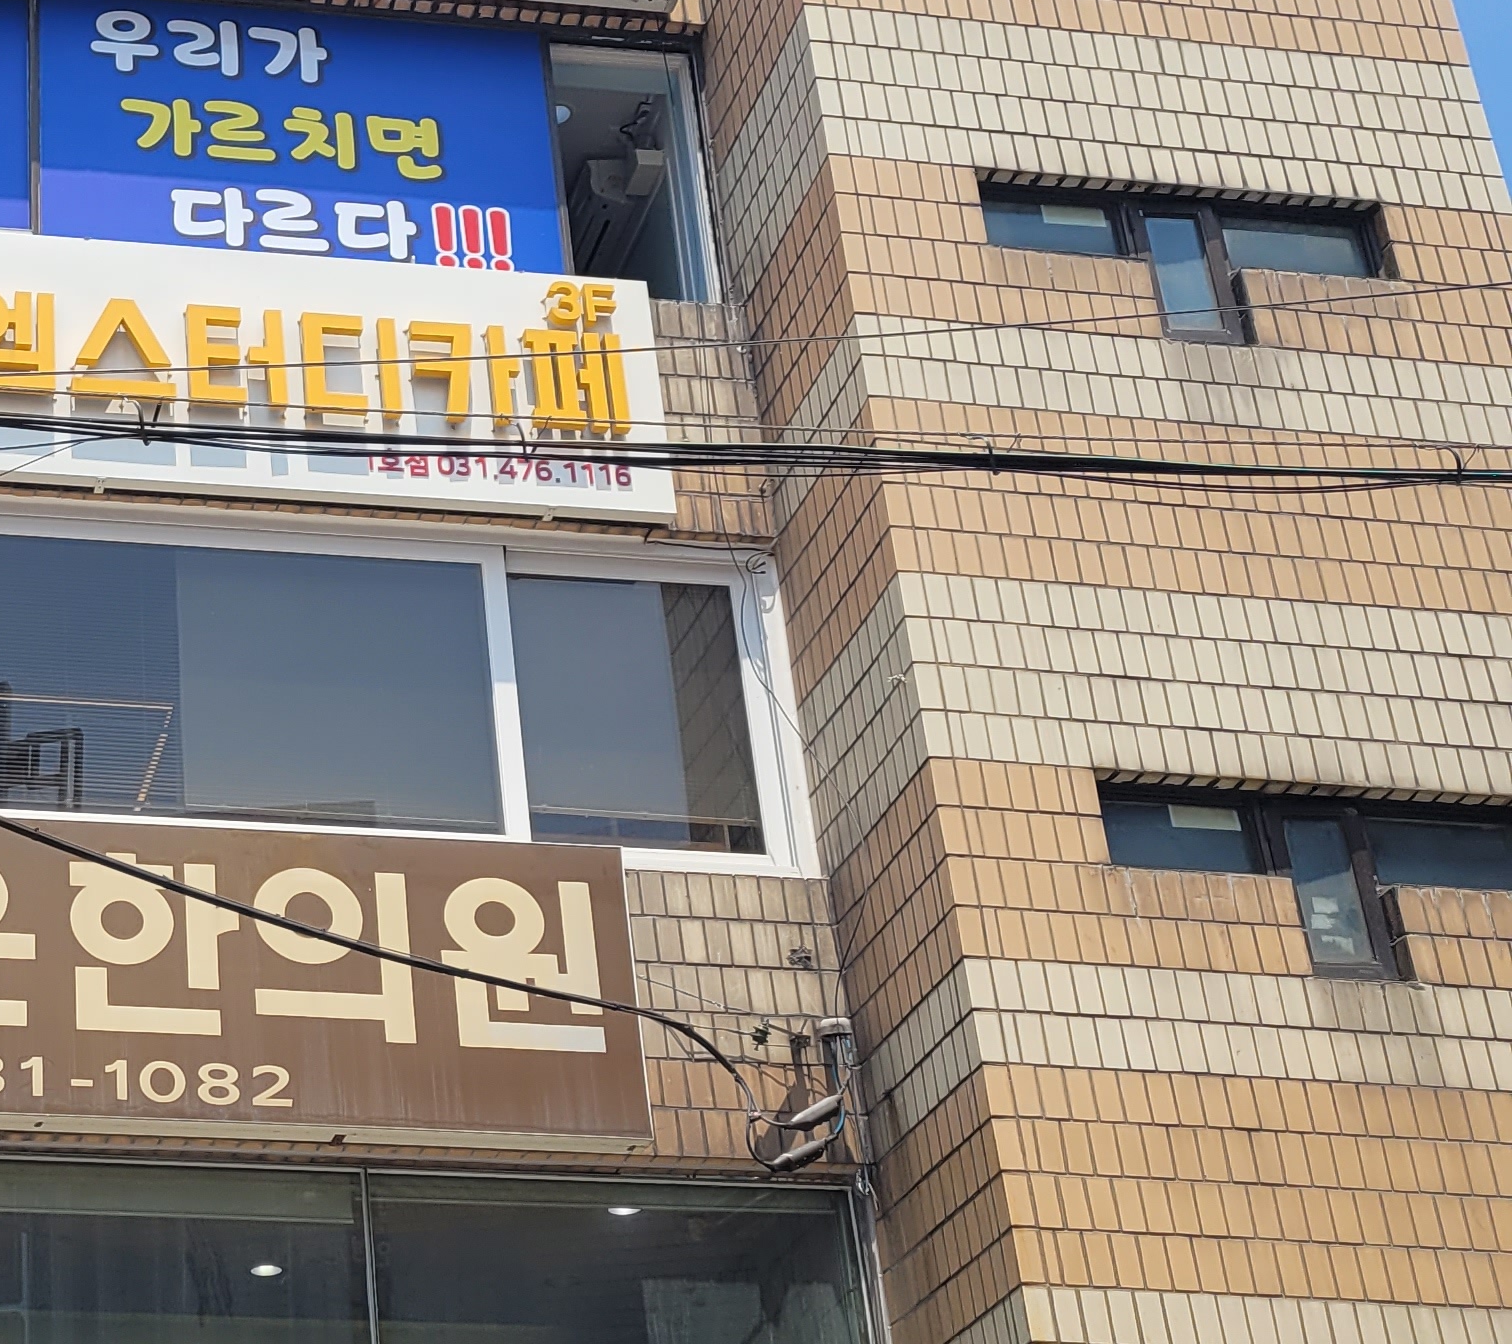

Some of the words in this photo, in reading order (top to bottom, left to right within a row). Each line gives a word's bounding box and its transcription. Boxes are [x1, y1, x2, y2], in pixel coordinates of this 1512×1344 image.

[90, 10, 328, 84] 우리가
[120, 98, 443, 181] 가르치면
[547, 281, 617, 327] 3F
